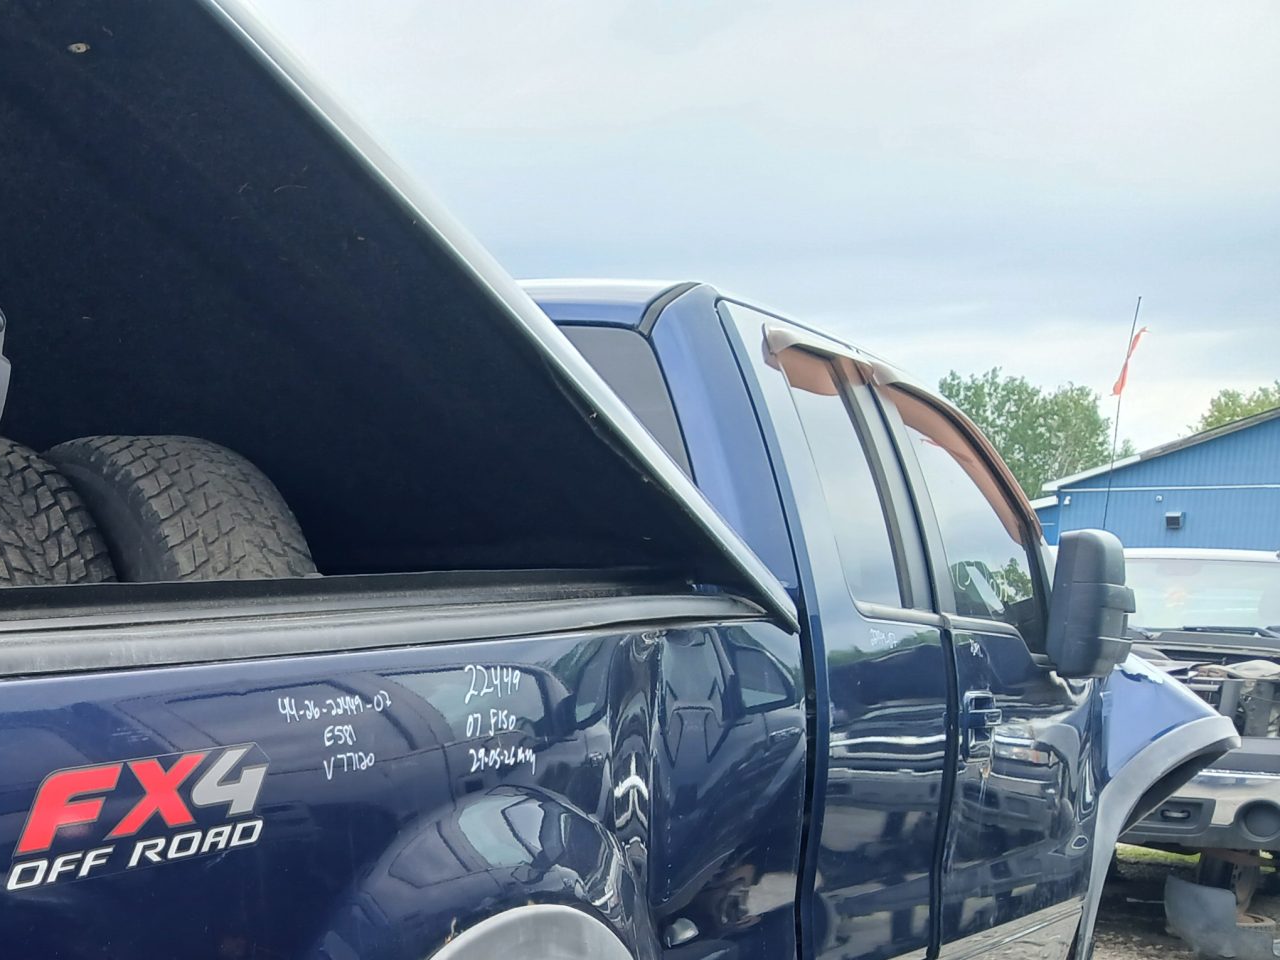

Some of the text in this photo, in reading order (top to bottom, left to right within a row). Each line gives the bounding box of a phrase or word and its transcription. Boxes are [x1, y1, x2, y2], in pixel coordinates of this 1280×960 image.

[464, 664, 520, 704] 22449
[466, 708, 516, 737] 07 F150
[15, 747, 269, 855] FX4
[6, 820, 264, 891] OFF ROAD
